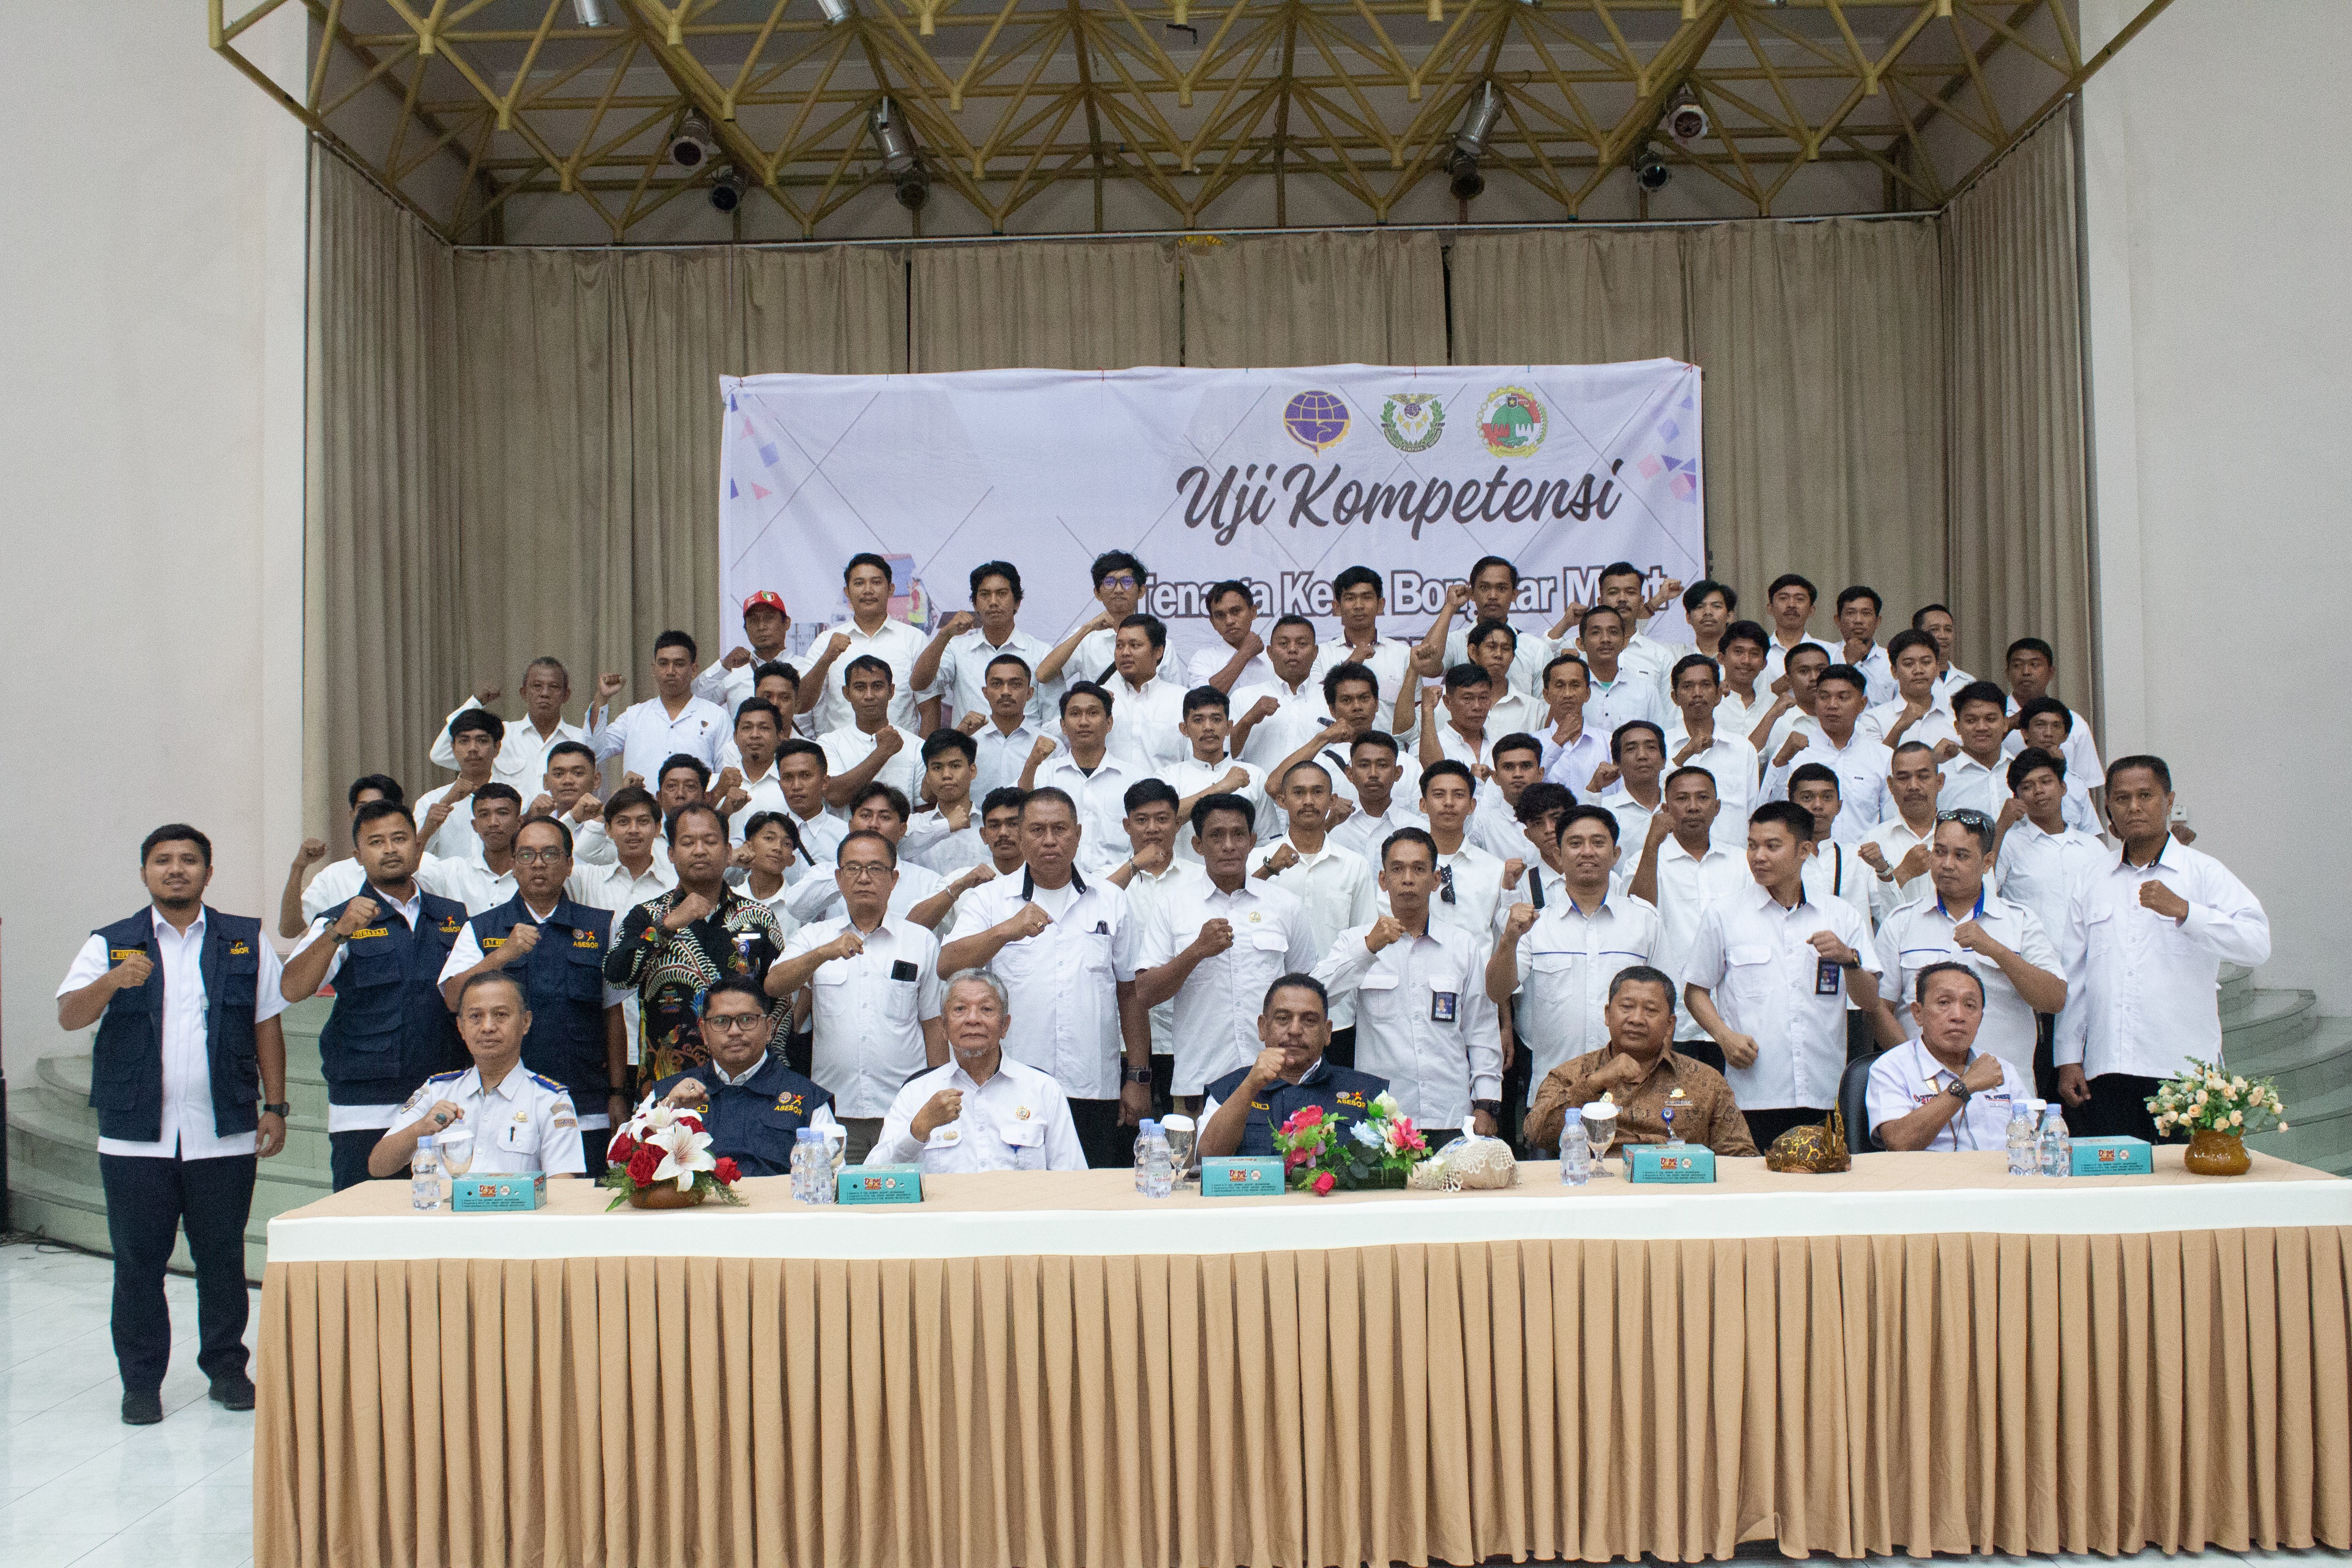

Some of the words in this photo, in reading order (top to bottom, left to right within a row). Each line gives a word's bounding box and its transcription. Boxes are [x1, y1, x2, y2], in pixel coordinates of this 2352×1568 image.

[1177, 463, 1276, 546] Uji
[1283, 459, 1623, 540] Kompetensi
[1134, 572, 1274, 618] Tena
[1391, 569, 1557, 622] Boar
[1563, 565, 1669, 611] Mt
[573, 941, 598, 949] ASESOR
[1337, 1098, 1366, 1110] ASESOR
[774, 1105, 803, 1117] ASESOR
